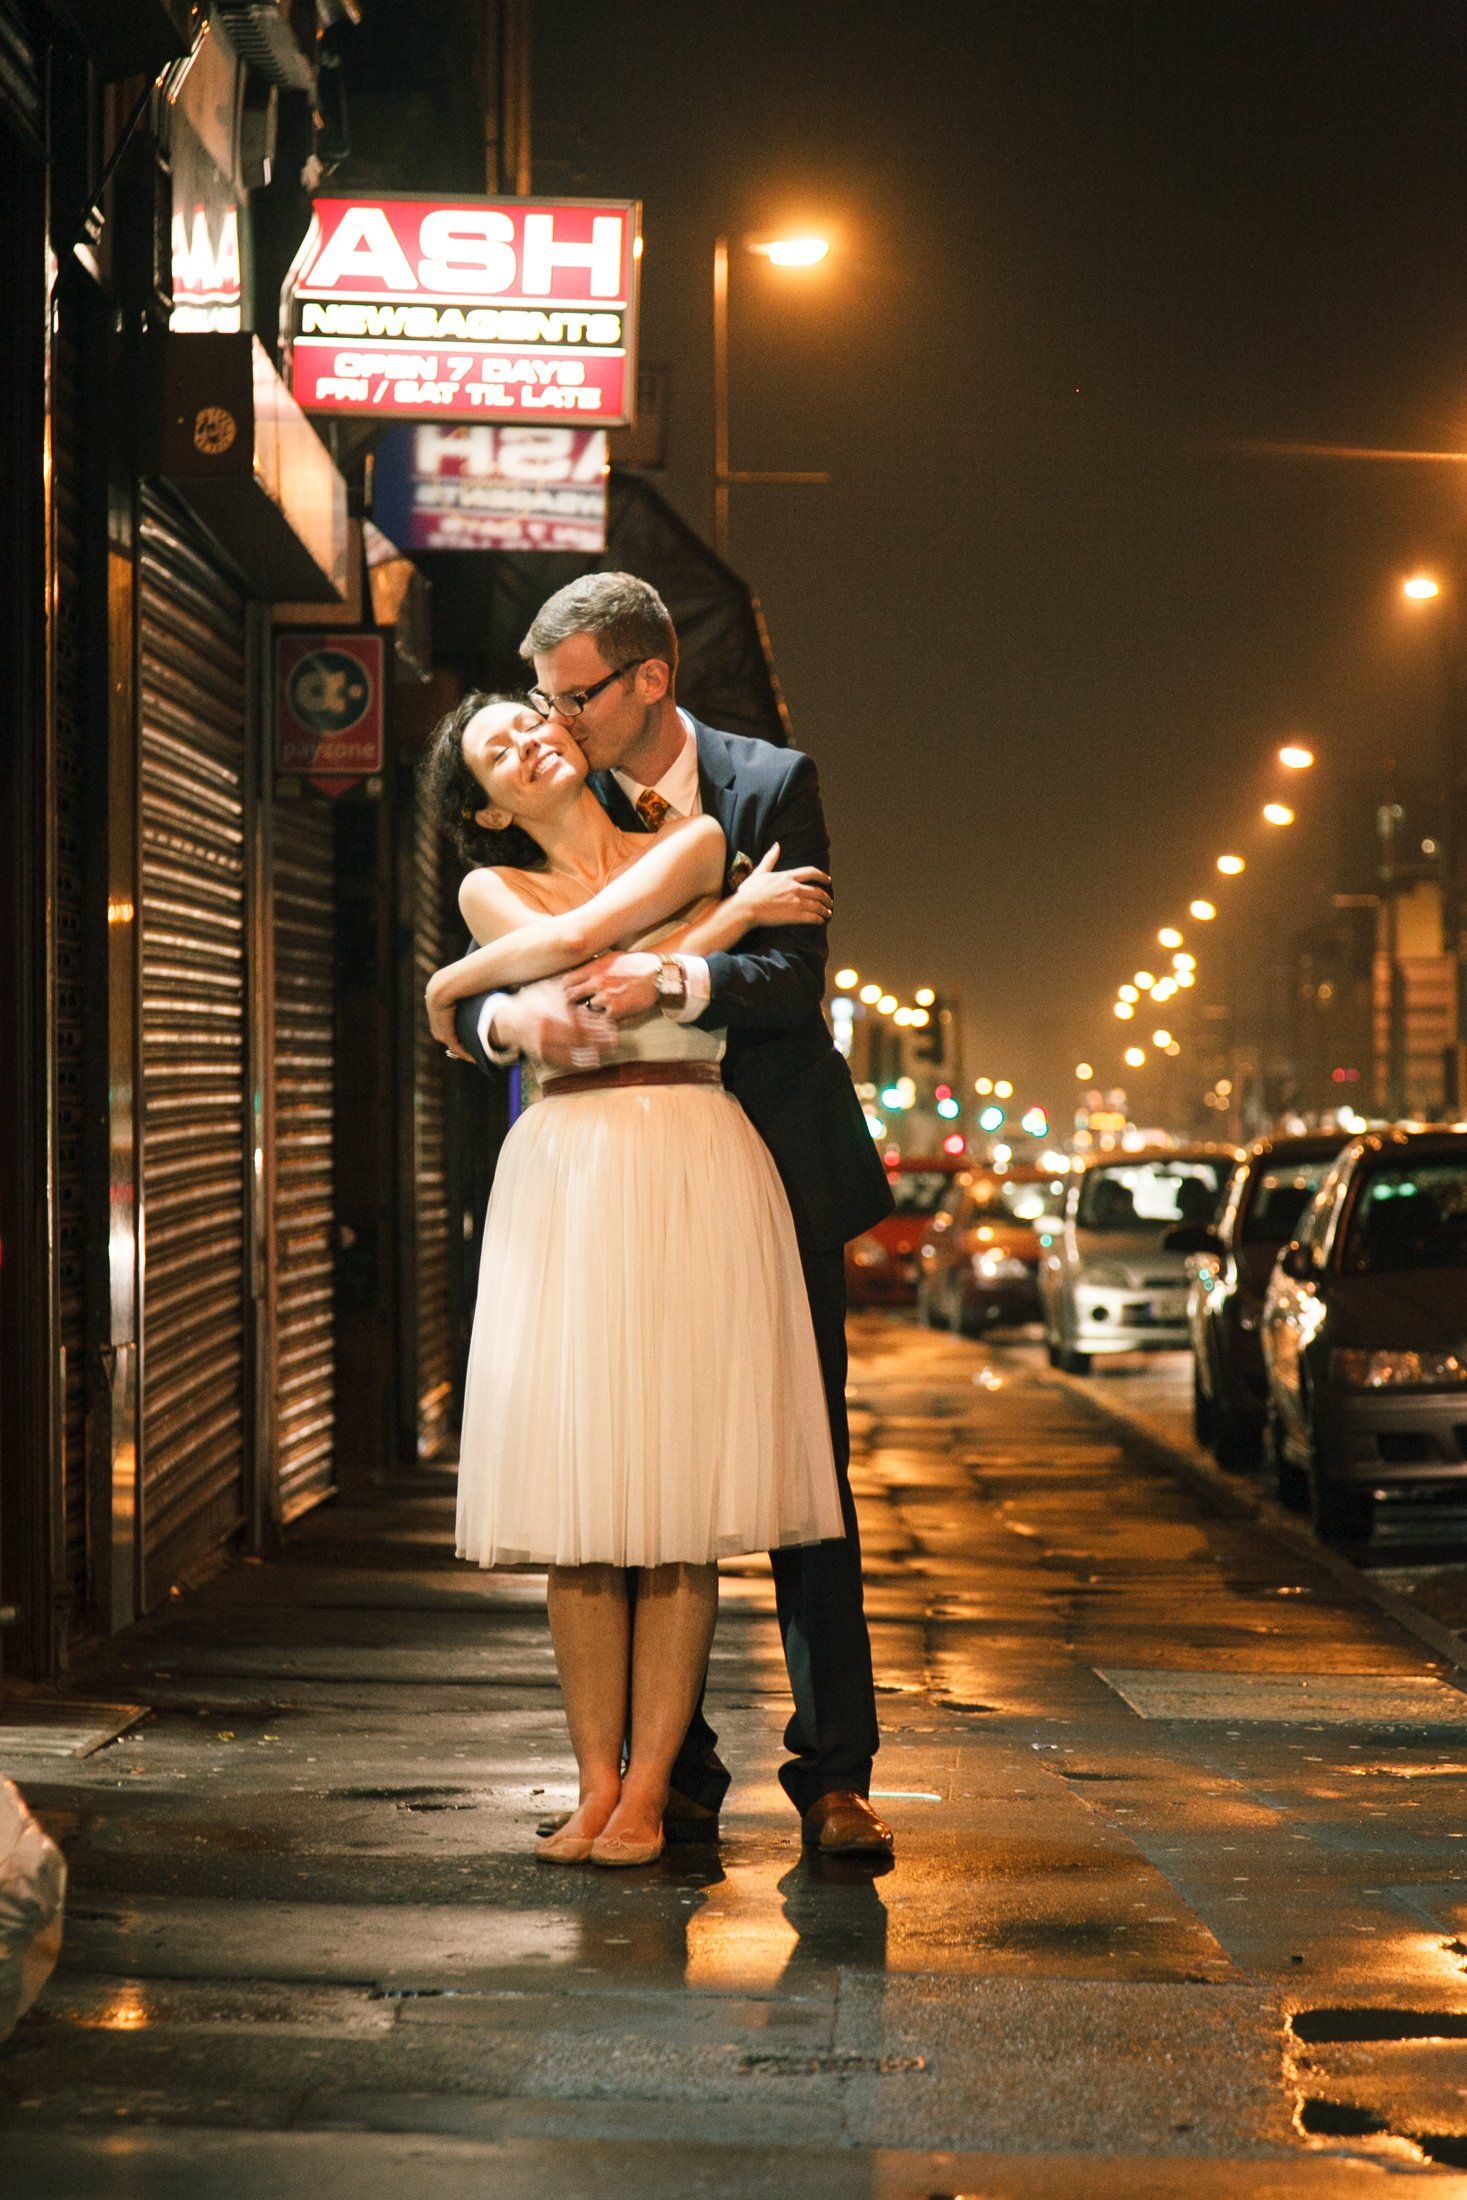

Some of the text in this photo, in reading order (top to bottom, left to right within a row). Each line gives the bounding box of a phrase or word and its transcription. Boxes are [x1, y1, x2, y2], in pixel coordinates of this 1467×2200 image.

[305, 207, 623, 297] ASH
[302, 303, 622, 344] NEWSAGENTS
[333, 352, 586, 386] OPEN 7 DAYS
[315, 377, 369, 402] FRI
[394, 380, 460, 404] SAT
[465, 382, 515, 407] TIL
[520, 384, 602, 410] LATE
